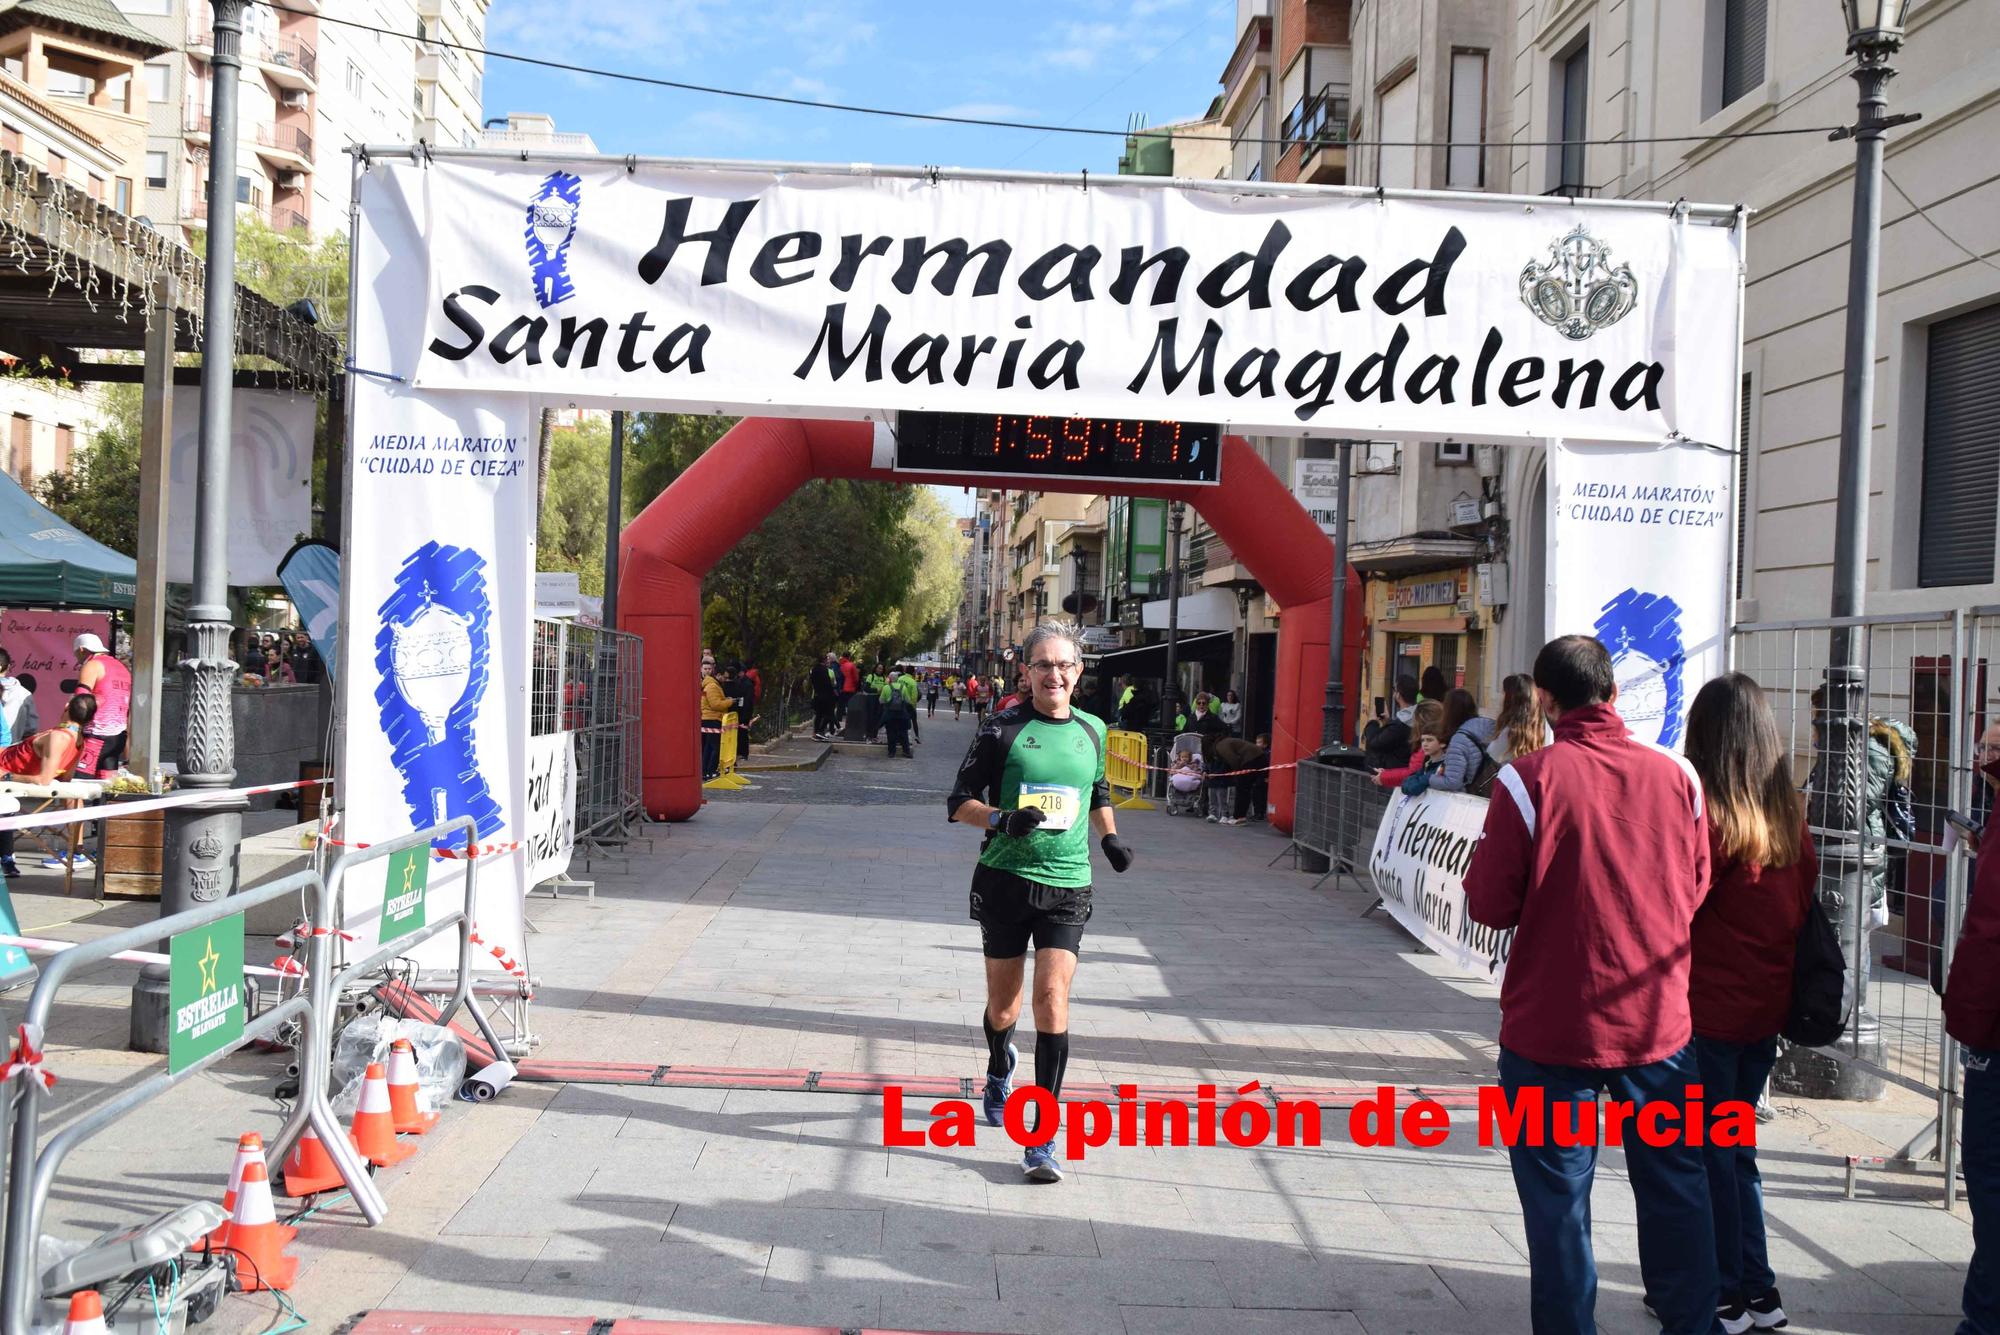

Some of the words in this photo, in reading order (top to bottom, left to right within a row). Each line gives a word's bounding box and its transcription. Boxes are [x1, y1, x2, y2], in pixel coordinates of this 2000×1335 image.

[637, 196, 1467, 317] Hermandad
[428, 285, 712, 375] Santa
[793, 302, 1085, 391] Maria
[1126, 316, 1665, 422] Magdalena
[369, 434, 426, 451] MEDIA
[432, 434, 517, 453] MARATÓN
[994, 414, 1181, 462] 1:59:47
[440, 459, 465, 475] DE
[1572, 482, 1627, 499] MEDIA
[1632, 484, 1715, 504] MARATÓN
[1640, 507, 1664, 524] DE
[1040, 795, 1062, 810] 218
[385, 887, 423, 916] ESTRELLA
[1413, 868, 1451, 936] Maria
[176, 983, 239, 1034] ESTRELLA
